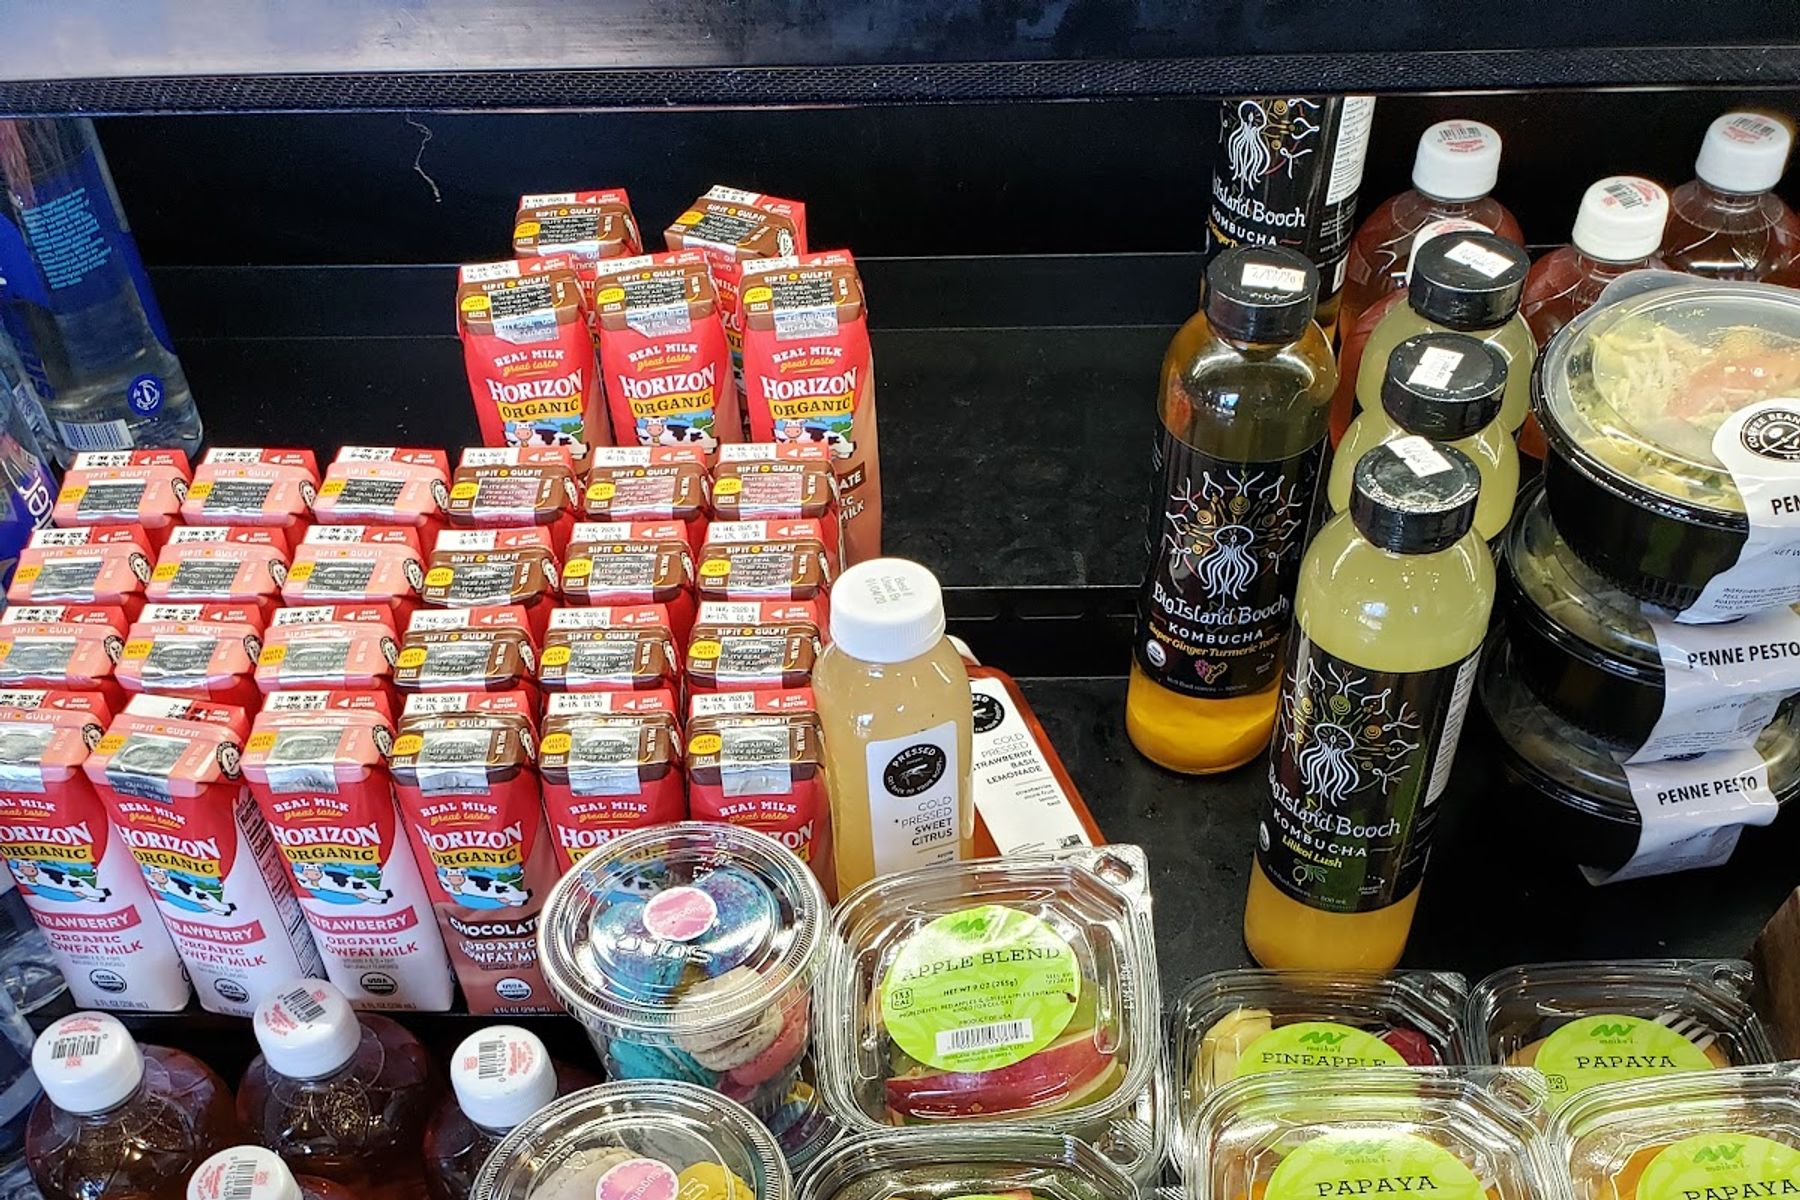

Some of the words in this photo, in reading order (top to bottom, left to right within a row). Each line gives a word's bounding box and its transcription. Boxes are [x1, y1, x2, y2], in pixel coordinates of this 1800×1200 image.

[1253, 199, 1306, 227] Booch
[494, 352, 527, 367] REAL
[531, 350, 564, 359] MILK
[628, 346, 661, 362] REAL
[665, 344, 698, 353] MILK
[772, 349, 806, 363] REAL
[810, 346, 843, 357] MILK
[486, 368, 582, 403] HORIZON
[619, 362, 715, 398] HORIZON
[760, 367, 857, 400] HORIZON
[503, 399, 579, 418] ORGANIC
[635, 393, 710, 414] ORGANIC
[774, 399, 850, 416] ORGANIC
[1153, 581, 1174, 614] Big
[1174, 598, 1234, 625] Island
[1238, 594, 1289, 624] Booch
[1169, 622, 1263, 644] KOMBUCHA
[1172, 639, 1208, 656] Ginger
[1209, 644, 1258, 656] Turmeric
[1688, 647, 1744, 669] PENNE
[1750, 642, 1800, 661] PESTO
[993, 732, 1024, 746] COLD
[893, 747, 936, 767] PRESSED
[981, 742, 1029, 758] PRESSED
[1011, 758, 1038, 769] BASIL
[987, 766, 1043, 785] LEMONADE
[1658, 783, 1710, 805] PENNE
[1714, 776, 1757, 795] PESTO
[21, 799, 56, 812] MILK
[273, 798, 310, 813] REAL
[314, 798, 349, 812] MILK
[420, 802, 457, 818] REAL
[461, 801, 498, 815] MILK
[569, 802, 607, 815] REAL
[611, 801, 648, 812] MILK
[719, 802, 756, 816] REAL
[761, 801, 797, 814] MILK
[918, 796, 952, 811] COLD
[1278, 784, 1332, 832] Island
[1336, 815, 1400, 838] Booch
[119, 803, 151, 812] REAL
[155, 806, 186, 824] MILK
[902, 807, 952, 829] PRESSED
[268, 822, 381, 847] HORIZON
[915, 818, 952, 835] SWEET
[1274, 808, 1366, 857] KOMBUCHA
[115, 824, 221, 860] HORIZON
[415, 821, 523, 851] HORIZON
[912, 828, 952, 846] CITRUS
[133, 850, 214, 874] ORGANIC
[286, 848, 374, 861] ORGANIC
[433, 848, 517, 865] ORGANIC
[1314, 854, 1342, 868] Lush
[52, 932, 122, 943] ORGANIC
[327, 936, 398, 945] ORGANIC
[466, 938, 536, 951] ORGANIC
[104, 940, 144, 955] MILK
[380, 941, 418, 957] MILK
[518, 950, 536, 962] MI
[228, 955, 267, 968] MILK
[902, 955, 974, 981] APPLE
[982, 948, 1061, 965] BLEND
[1574, 1055, 1677, 1069] PAPAYA
[1315, 1174, 1438, 1198] PAPAYA
